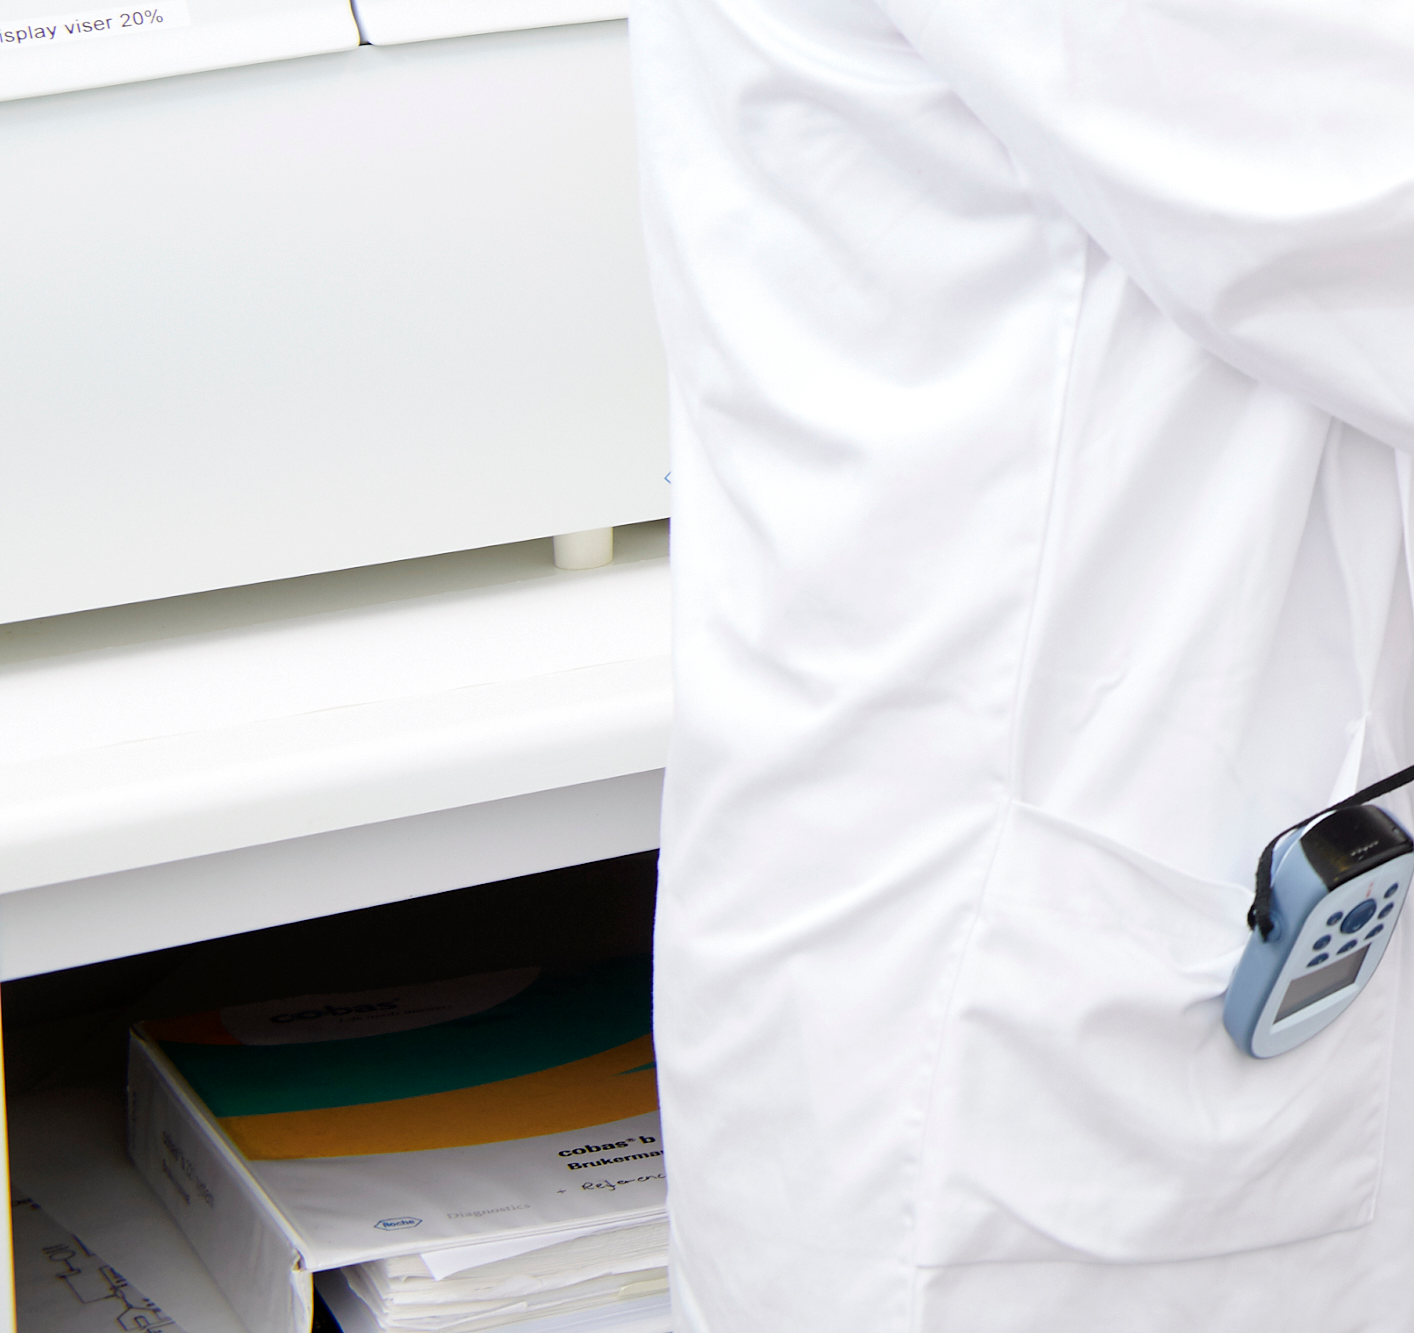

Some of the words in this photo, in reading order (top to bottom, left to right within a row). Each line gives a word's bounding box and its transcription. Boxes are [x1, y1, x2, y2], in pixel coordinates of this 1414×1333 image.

[65, 18, 113, 35] viser
[120, 9, 164, 28] 20%
[639, 1136, 656, 1144] b
[447, 1203, 531, 1219] Diagnostics
[382, 1219, 416, 1228] Roche
